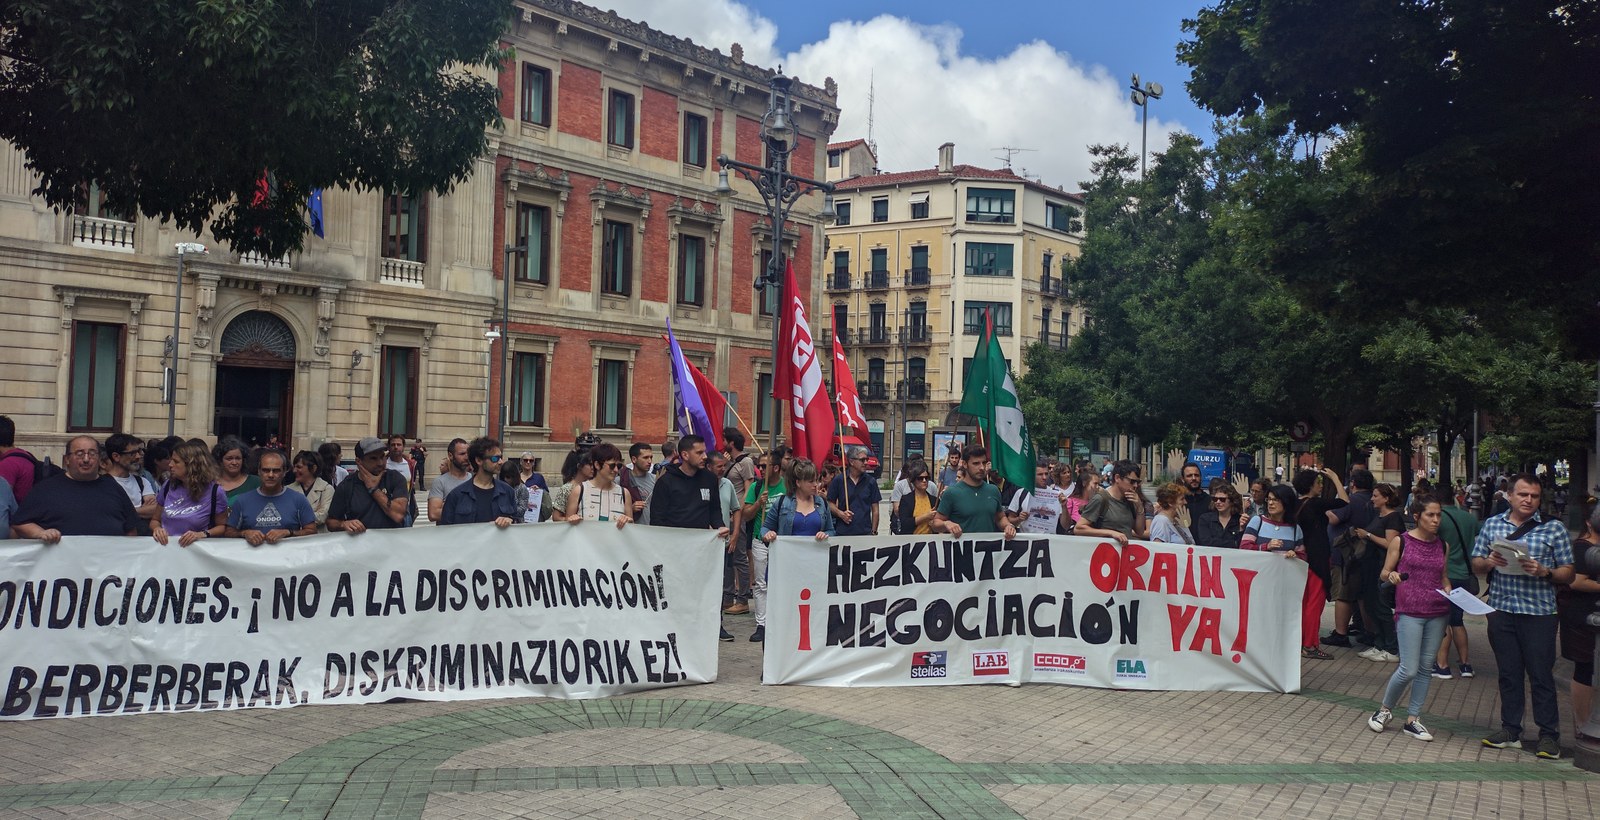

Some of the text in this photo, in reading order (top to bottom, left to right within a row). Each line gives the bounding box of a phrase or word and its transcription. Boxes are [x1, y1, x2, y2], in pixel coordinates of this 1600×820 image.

[1194, 455, 1221, 463] IZURZU
[827, 539, 1225, 598] HEZKUNTZA ORAIN
[331, 572, 354, 617] A
[366, 569, 406, 616] LA
[414, 561, 668, 612] DISCRIMINACIÓN!
[826, 589, 1139, 648] NEGOCIACIÓN
[324, 638, 639, 699] DISKRIMINAZIORIK
[640, 633, 688, 684] EZ!
[975, 654, 1007, 668] LAB
[1036, 655, 1069, 665] CCOO
[1117, 659, 1146, 674] ELA
